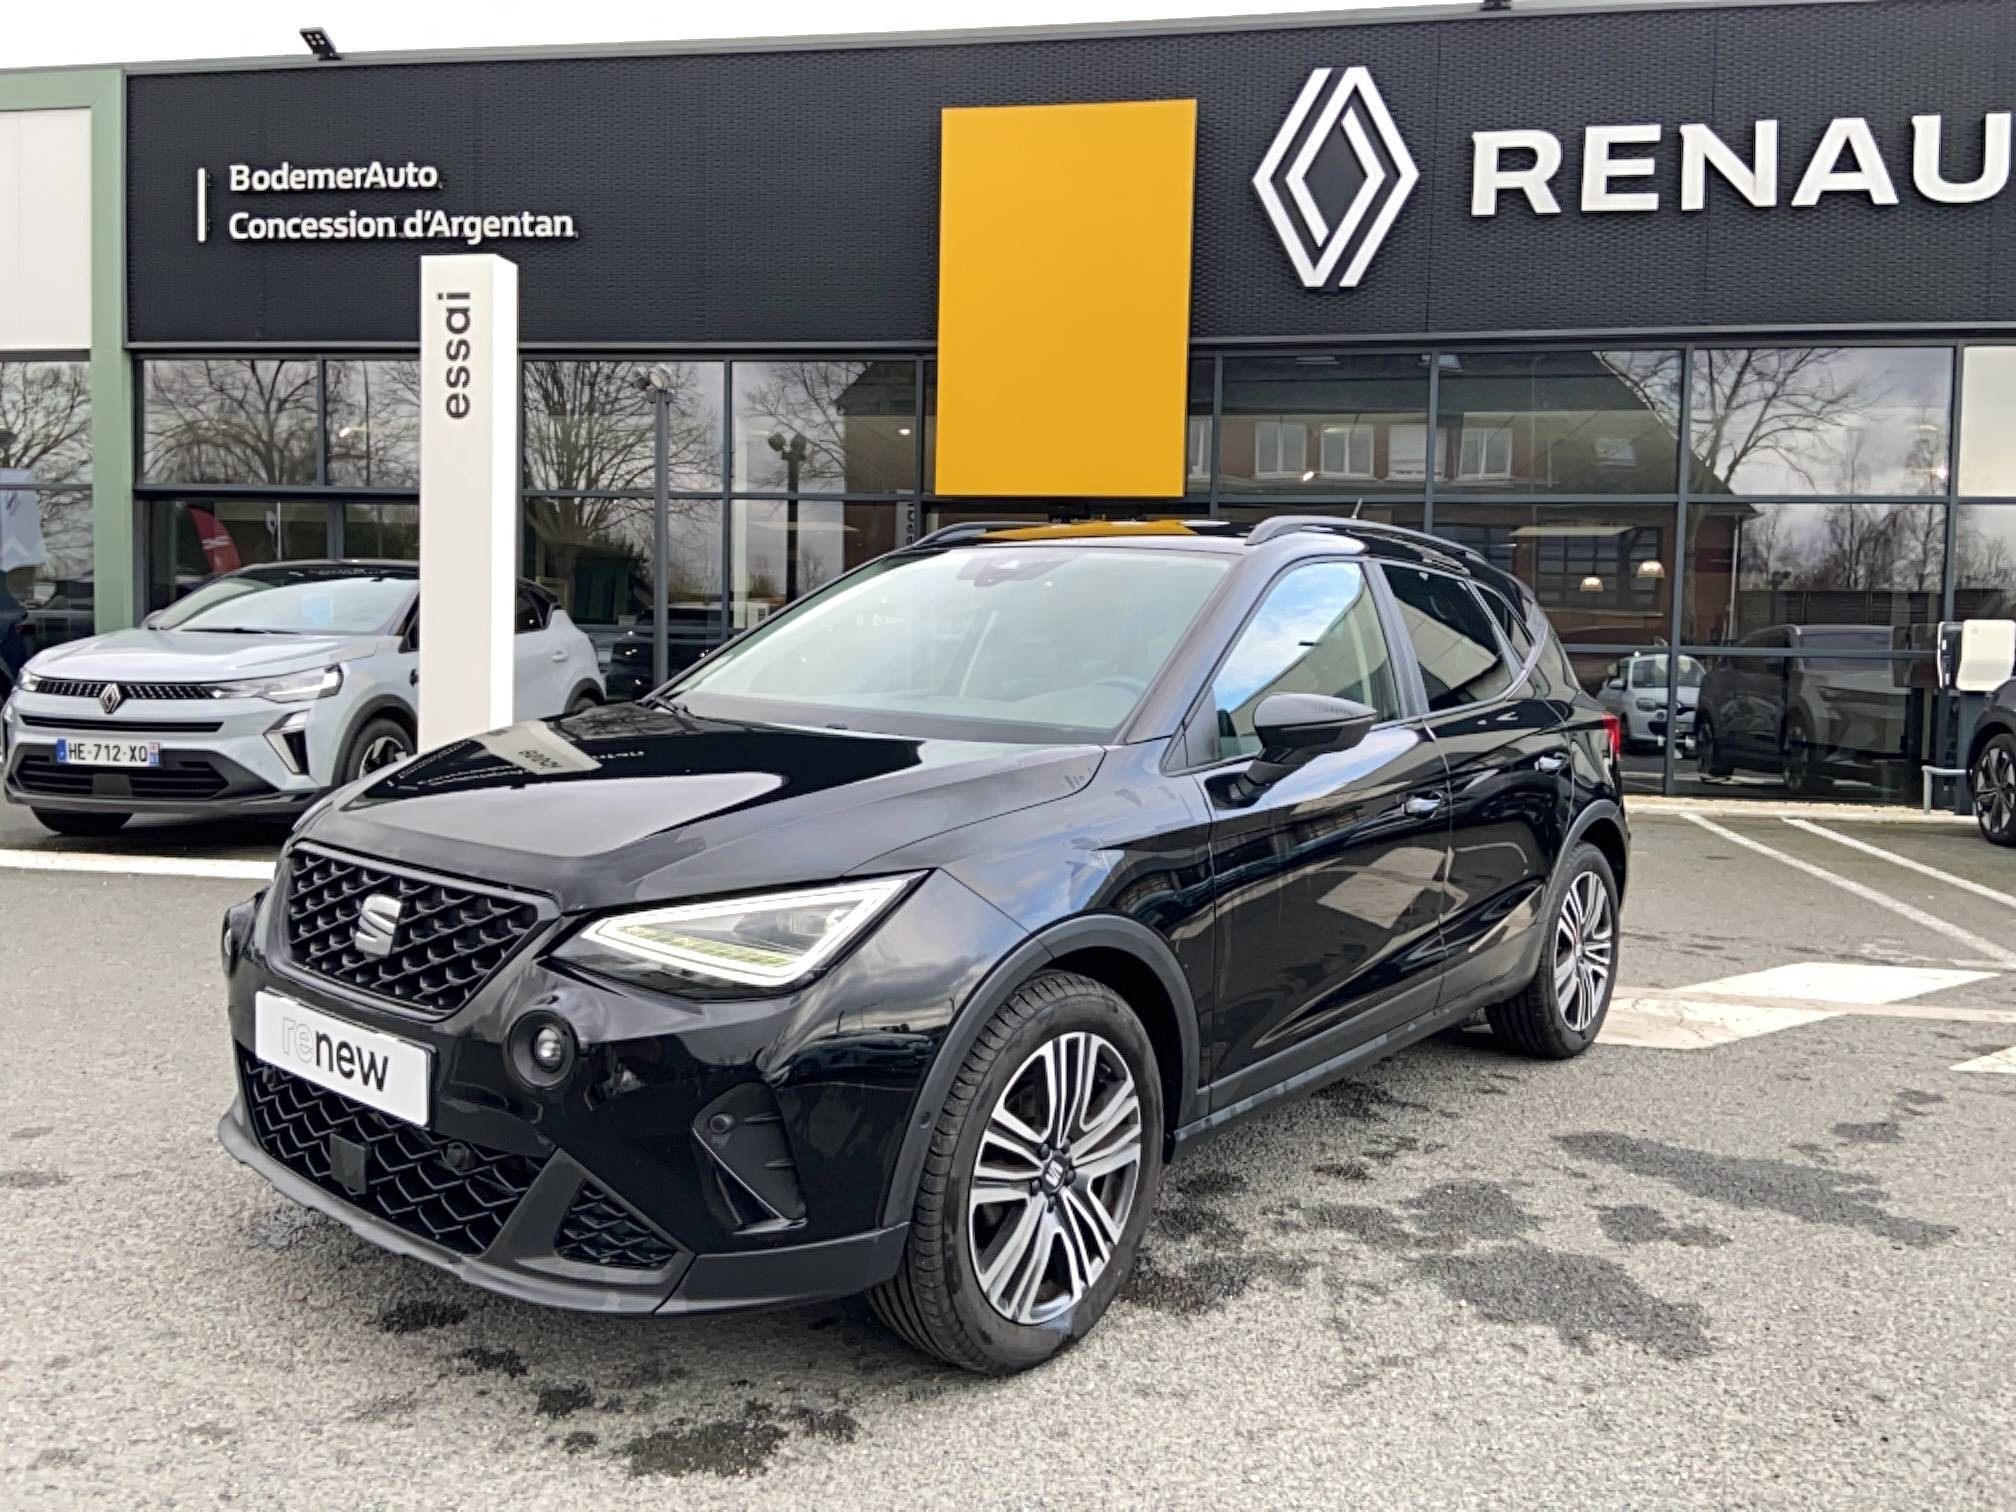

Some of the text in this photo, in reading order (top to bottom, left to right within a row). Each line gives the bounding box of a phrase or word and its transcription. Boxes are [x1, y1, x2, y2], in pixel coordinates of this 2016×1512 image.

[228, 161, 439, 191] BodemerAuto
[1471, 111, 2012, 217] RENAU
[228, 209, 575, 245] Concession d’Argentan
[437, 292, 471, 420] essai
[282, 1016, 389, 1092] renew
